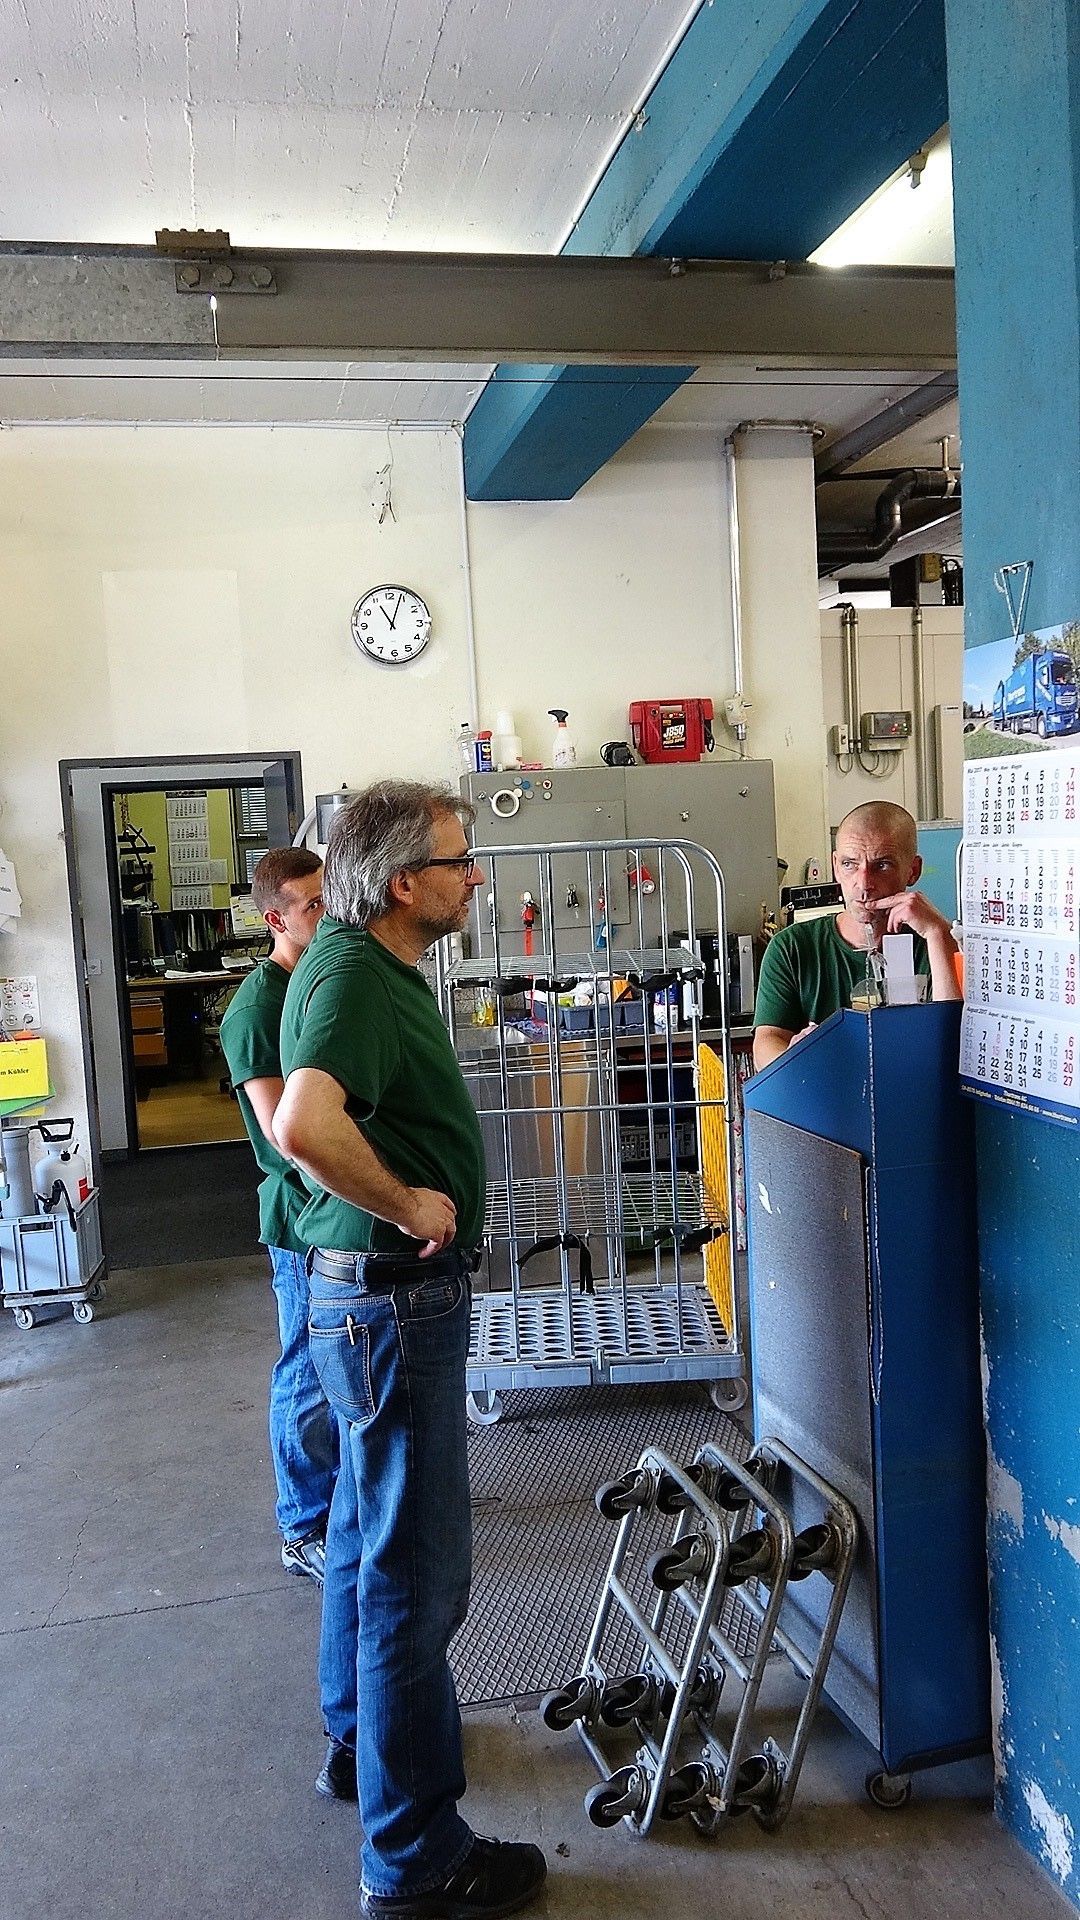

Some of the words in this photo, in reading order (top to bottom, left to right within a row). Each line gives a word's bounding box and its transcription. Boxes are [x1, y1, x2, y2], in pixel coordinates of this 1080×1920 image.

[663, 725, 684, 738] J850
[986, 777, 988, 785] 1
[998, 775, 1002, 784] 2
[1011, 773, 1015, 783] 3
[1025, 772, 1029, 781] 4
[1040, 770, 1044, 780] 5
[1070, 768, 1075, 778] 7
[985, 788, 989, 797] 8
[997, 787, 1002, 796] 9
[1007, 786, 1015, 795] 10
[1022, 785, 1029, 795] 11
[1036, 784, 1044, 793] 12
[1066, 781, 1075, 791] 14
[982, 801, 988, 810] 15
[994, 800, 1001, 809] 16
[1008, 799, 1015, 808] 17
[1022, 798, 1029, 807] 18
[1036, 797, 1044, 807] 19
[1066, 795, 1075, 805] 21
[981, 813, 988, 822] 22
[993, 812, 1001, 821] 23
[1007, 812, 1015, 821] 24
[1020, 811, 1029, 821] 25
[1034, 810, 1044, 820] 26
[1065, 809, 1075, 819] 28
[980, 825, 988, 834] 29
[993, 825, 1001, 834] 30
[1007, 824, 1015, 834] 31
[1025, 866, 1028, 876] 1
[1039, 866, 1043, 876] 2
[1069, 867, 1073, 876] 4
[984, 878, 988, 887] 5
[997, 878, 1001, 887] 6
[1010, 879, 1014, 888] 7
[1025, 879, 1029, 888] 8
[1039, 879, 1043, 889] 9
[1066, 881, 1073, 890] 11
[981, 890, 988, 899] 12
[993, 890, 1000, 900] 13
[1007, 891, 1014, 900] 14
[1034, 892, 1042, 902] 16
[1065, 894, 1073, 904] 18
[1007, 904, 1014, 913] 21
[1020, 905, 1028, 914] 22
[1034, 906, 1043, 915] 23
[1064, 907, 1073, 917] 25
[1007, 916, 1015, 926] 28
[1020, 917, 1028, 927] 29
[1034, 918, 1043, 928] 30
[1069, 921, 1074, 931] 2
[985, 944, 989, 953] 3
[997, 946, 1001, 955] 4
[1011, 947, 1015, 957] 5
[1024, 949, 1029, 959] 6
[1038, 951, 1043, 960] 7
[1069, 954, 1075, 964] 9
[982, 956, 989, 966] 10
[995, 958, 1001, 967] 11
[1008, 960, 1015, 969] 12
[1021, 962, 1029, 971] 13
[1035, 964, 1043, 973] 14
[1066, 968, 1075, 978] 16
[982, 969, 988, 978] 17
[995, 970, 1002, 980] 18
[1008, 973, 1015, 982] 19
[1021, 974, 1029, 984] 20
[1035, 976, 1043, 986] 21
[1065, 981, 1075, 991] 23
[981, 980, 989, 990] 24
[994, 982, 1002, 992] 25
[1007, 985, 1015, 995] 26
[1021, 987, 1029, 997] 27
[1035, 989, 1044, 999] 28
[1065, 994, 1075, 1005] 30
[982, 992, 989, 1002] 31
[997, 1022, 1001, 1031] 1
[1010, 1025, 1015, 1034] 2
[1024, 1027, 1028, 1037] 3
[1038, 1031, 1043, 1040] 4
[1069, 1037, 1074, 1047] 6
[982, 1031, 987, 1040] 7
[1010, 1037, 1014, 1046] 9
[1020, 1040, 1028, 1049] 10
[1035, 1043, 1041, 1053] 11
[1065, 1050, 1073, 1060] 13
[979, 1043, 986, 1052] 14
[1006, 1049, 1013, 1059] 16
[1020, 1052, 1026, 1062] 17
[1034, 1056, 1042, 1066] 18
[1064, 1062, 1073, 1073] 20
[977, 1066, 986, 1076] 28
[990, 1070, 999, 1080] 29
[1004, 1073, 1013, 1083] 30
[1018, 1077, 1027, 1087] 31
[978, 1054, 985, 1064] 21
[991, 1057, 1000, 1068] 22
[1004, 1061, 1013, 1071] 23
[1018, 1064, 1027, 1075] 24
[1033, 1068, 1042, 1078] 25
[1064, 1076, 1073, 1086] 27
